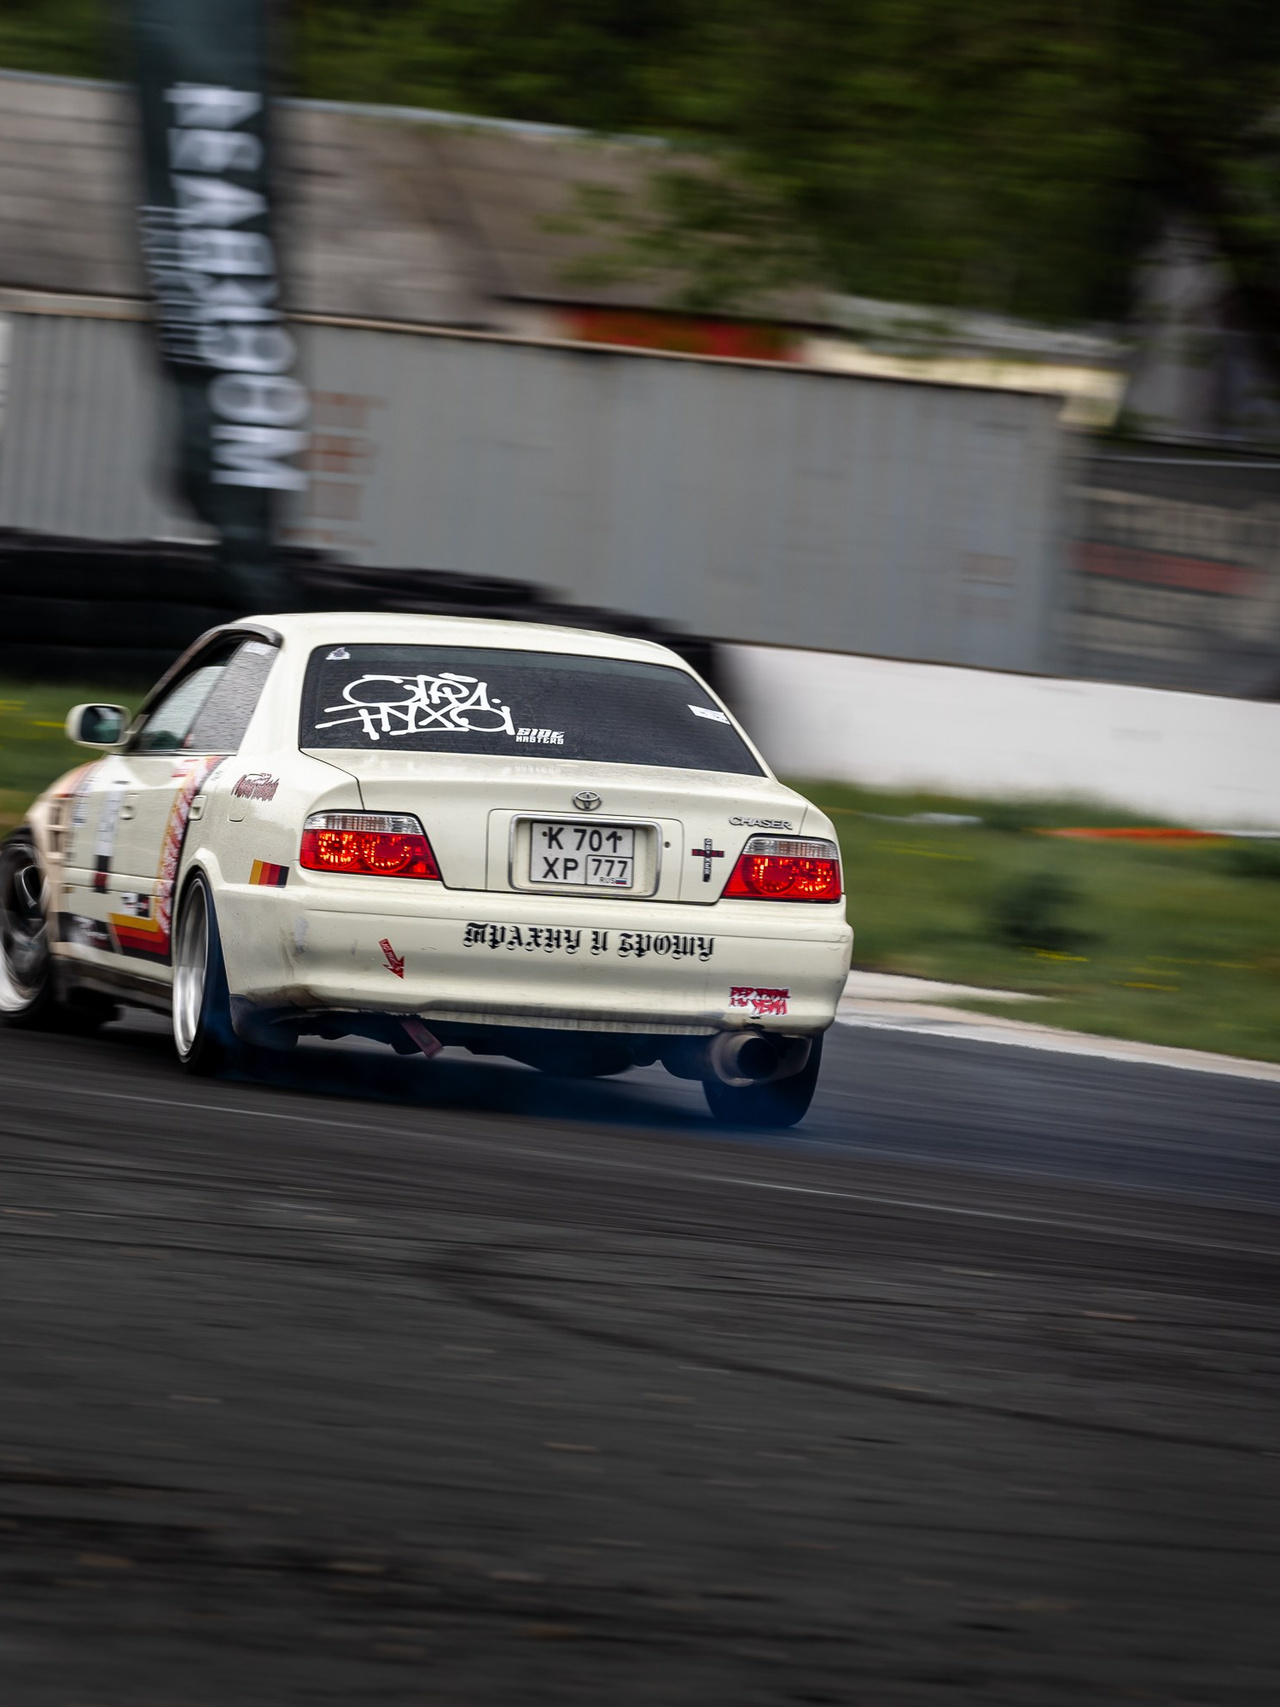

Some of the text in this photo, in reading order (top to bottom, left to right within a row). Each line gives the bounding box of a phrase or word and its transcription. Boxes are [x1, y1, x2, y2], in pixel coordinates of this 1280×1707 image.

[728, 815, 793, 831] CHASER
[547, 826, 619, 854] К 701
[542, 856, 629, 880] ХР 777
[599, 876, 616, 885] RUS
